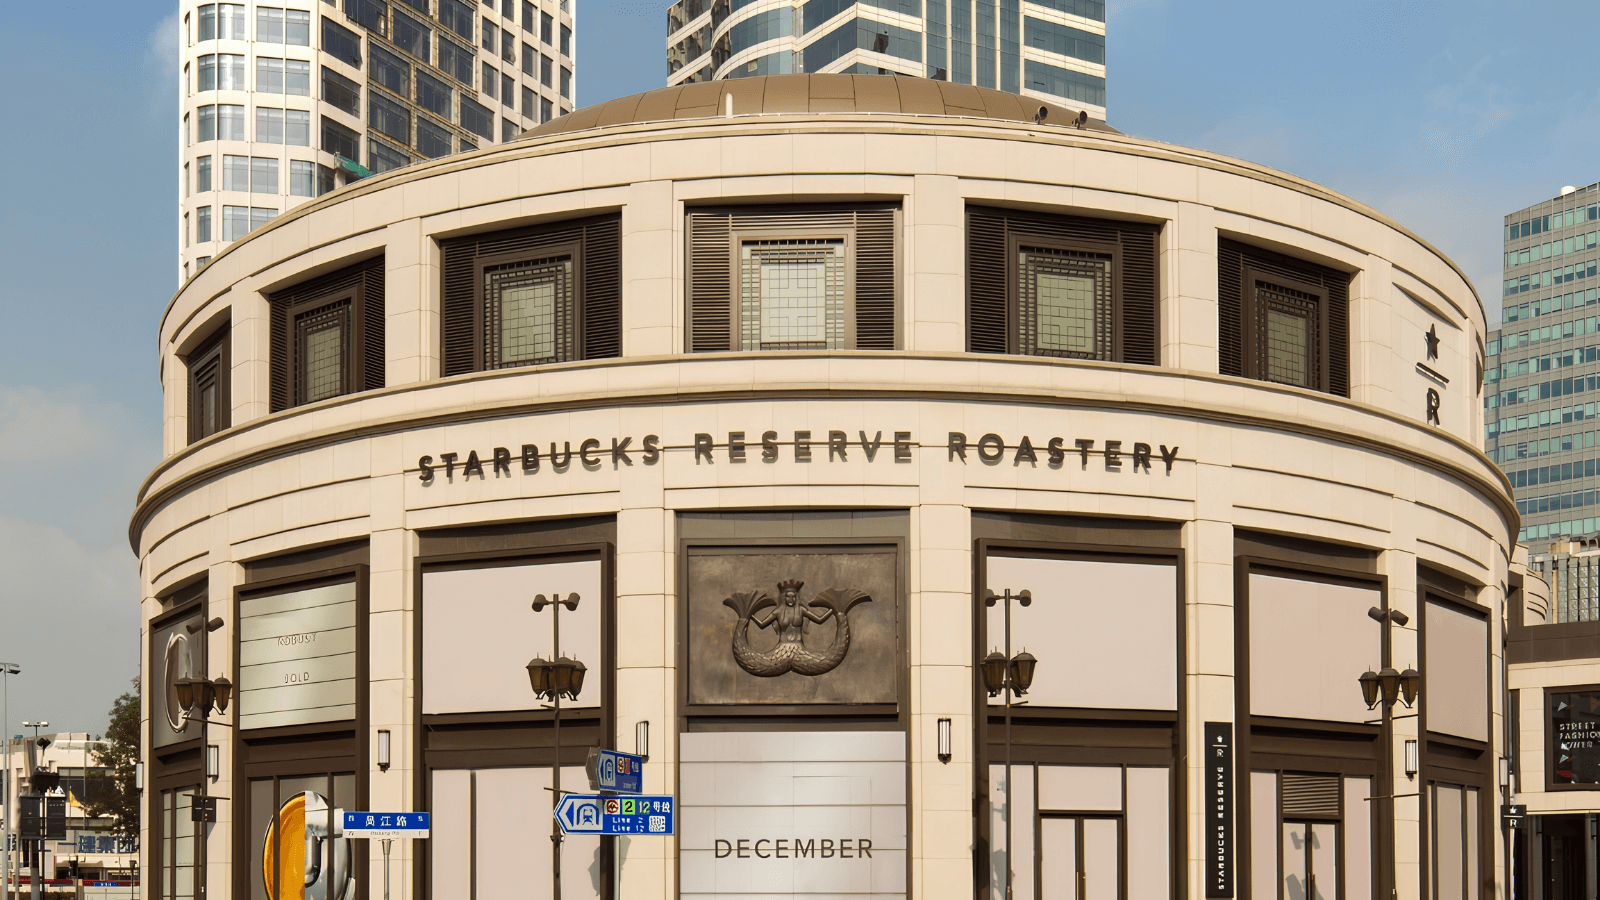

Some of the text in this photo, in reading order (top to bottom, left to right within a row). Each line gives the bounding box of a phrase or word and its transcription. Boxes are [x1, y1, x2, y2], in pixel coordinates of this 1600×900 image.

[1427, 387, 1440, 426] R
[418, 430, 1180, 484] STARBUCKS RESERVE ROASTERY
[624, 800, 634, 813] 2
[638, 800, 651, 814] 12
[1216, 766, 1225, 890] STARBUCKS RESERVE
[714, 838, 873, 859] DECEMBER
